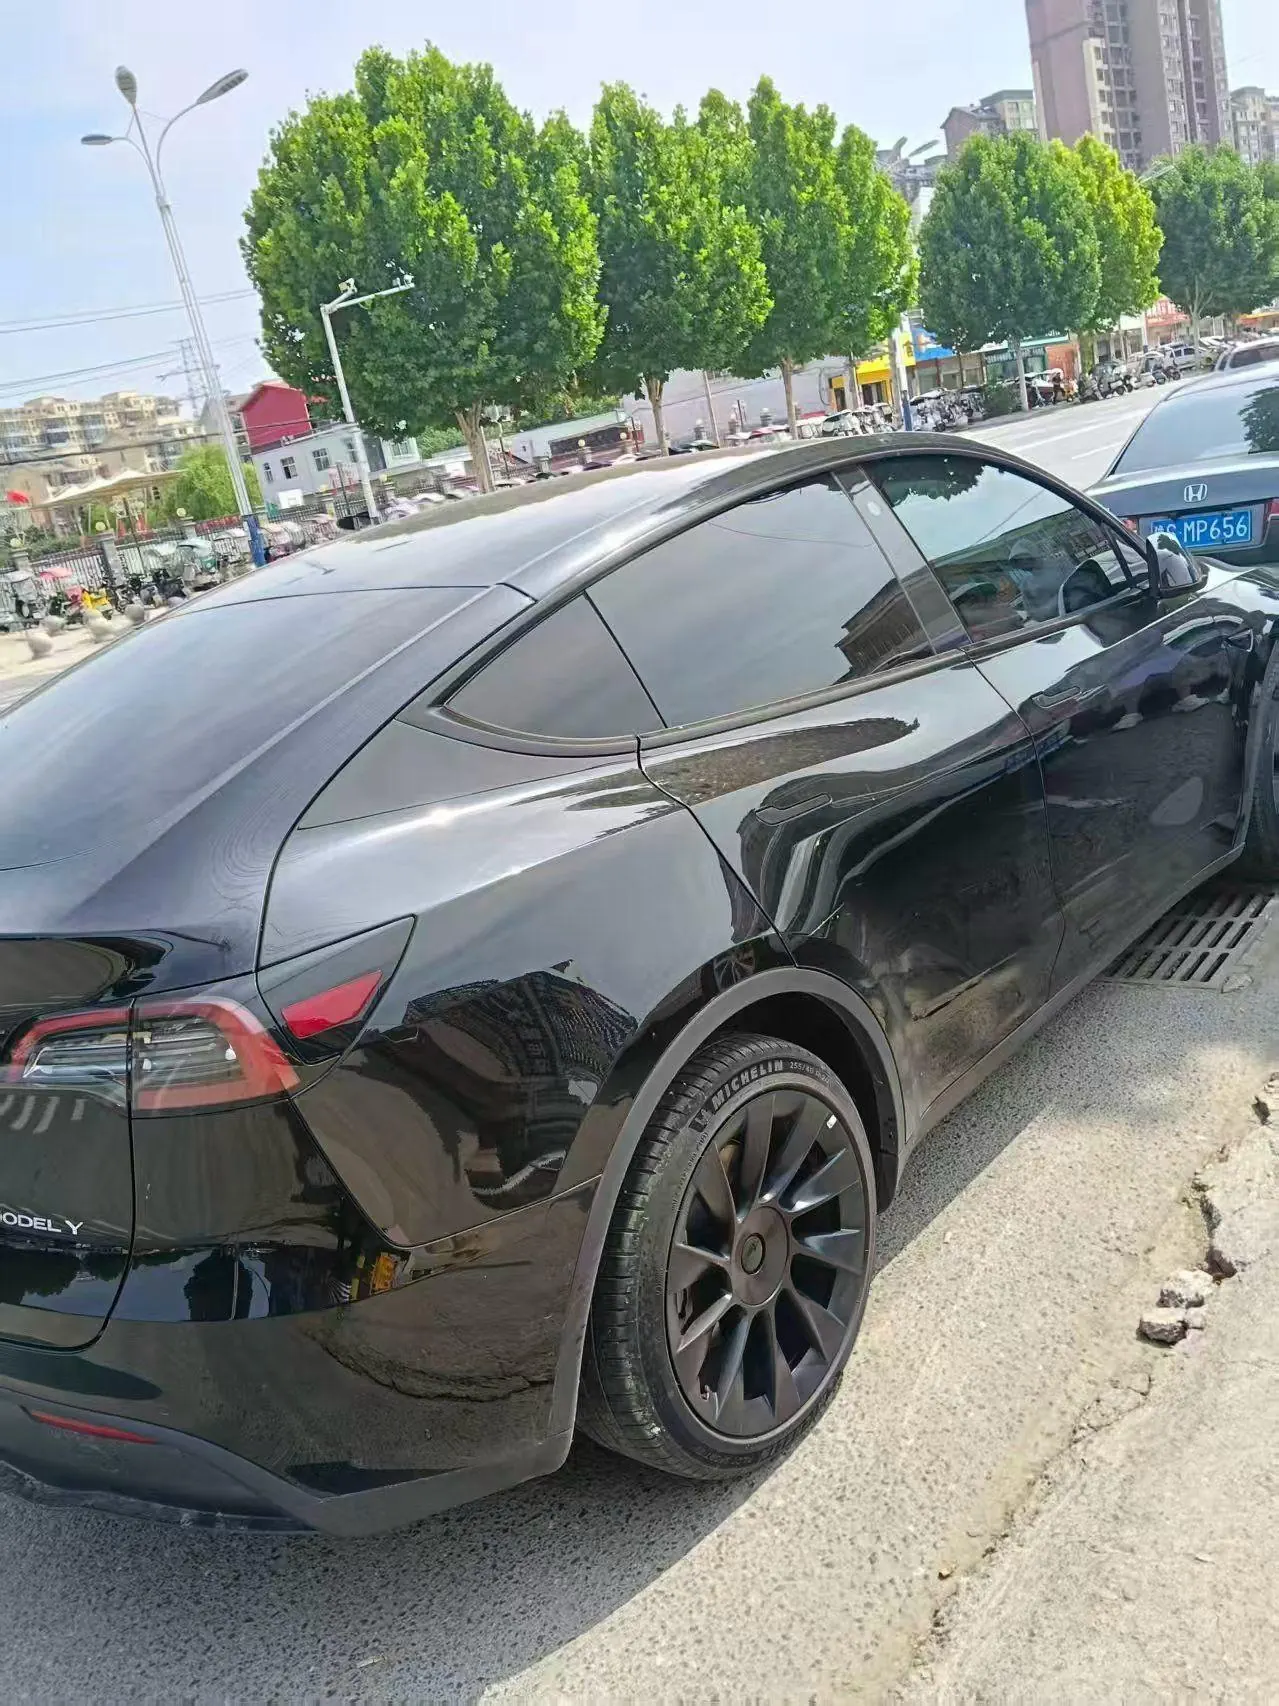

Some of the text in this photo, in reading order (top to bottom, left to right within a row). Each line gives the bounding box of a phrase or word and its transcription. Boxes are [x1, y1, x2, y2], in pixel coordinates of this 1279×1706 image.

[711, 1059, 783, 1110] MICHELIN
[0, 1212, 84, 1235] ODEL Y
